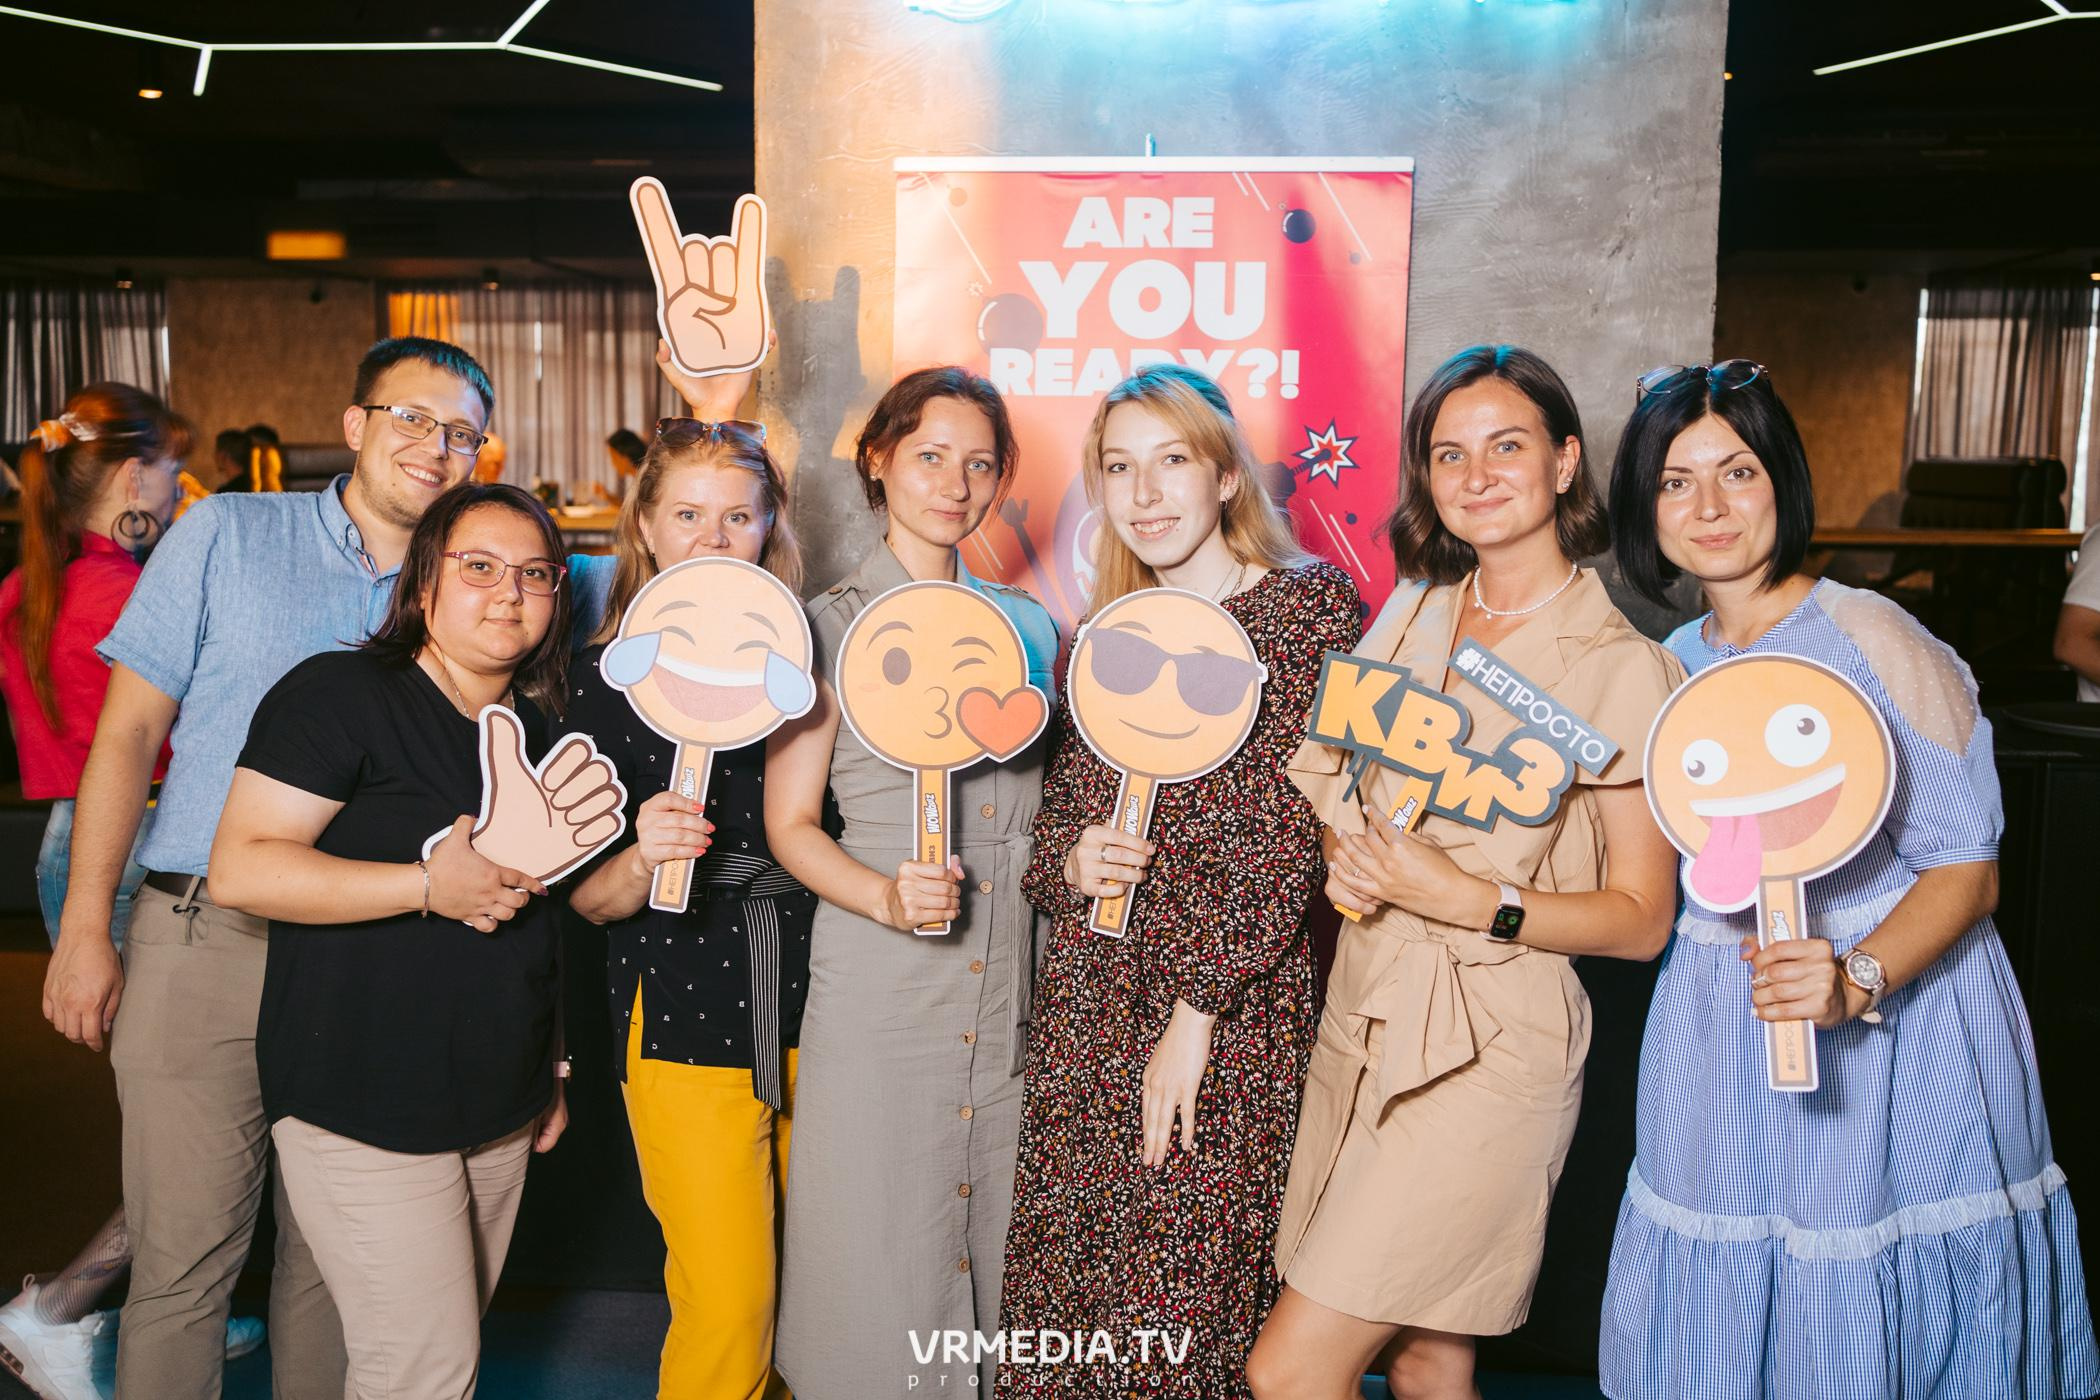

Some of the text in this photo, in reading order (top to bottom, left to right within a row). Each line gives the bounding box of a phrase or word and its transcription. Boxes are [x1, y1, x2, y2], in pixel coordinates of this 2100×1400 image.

[1063, 197, 1214, 248] ARE
[1018, 259, 1267, 341] YOU
[1316, 659, 1565, 822] КВИЗ
[1455, 648, 1606, 764] #НЕПРОСТО
